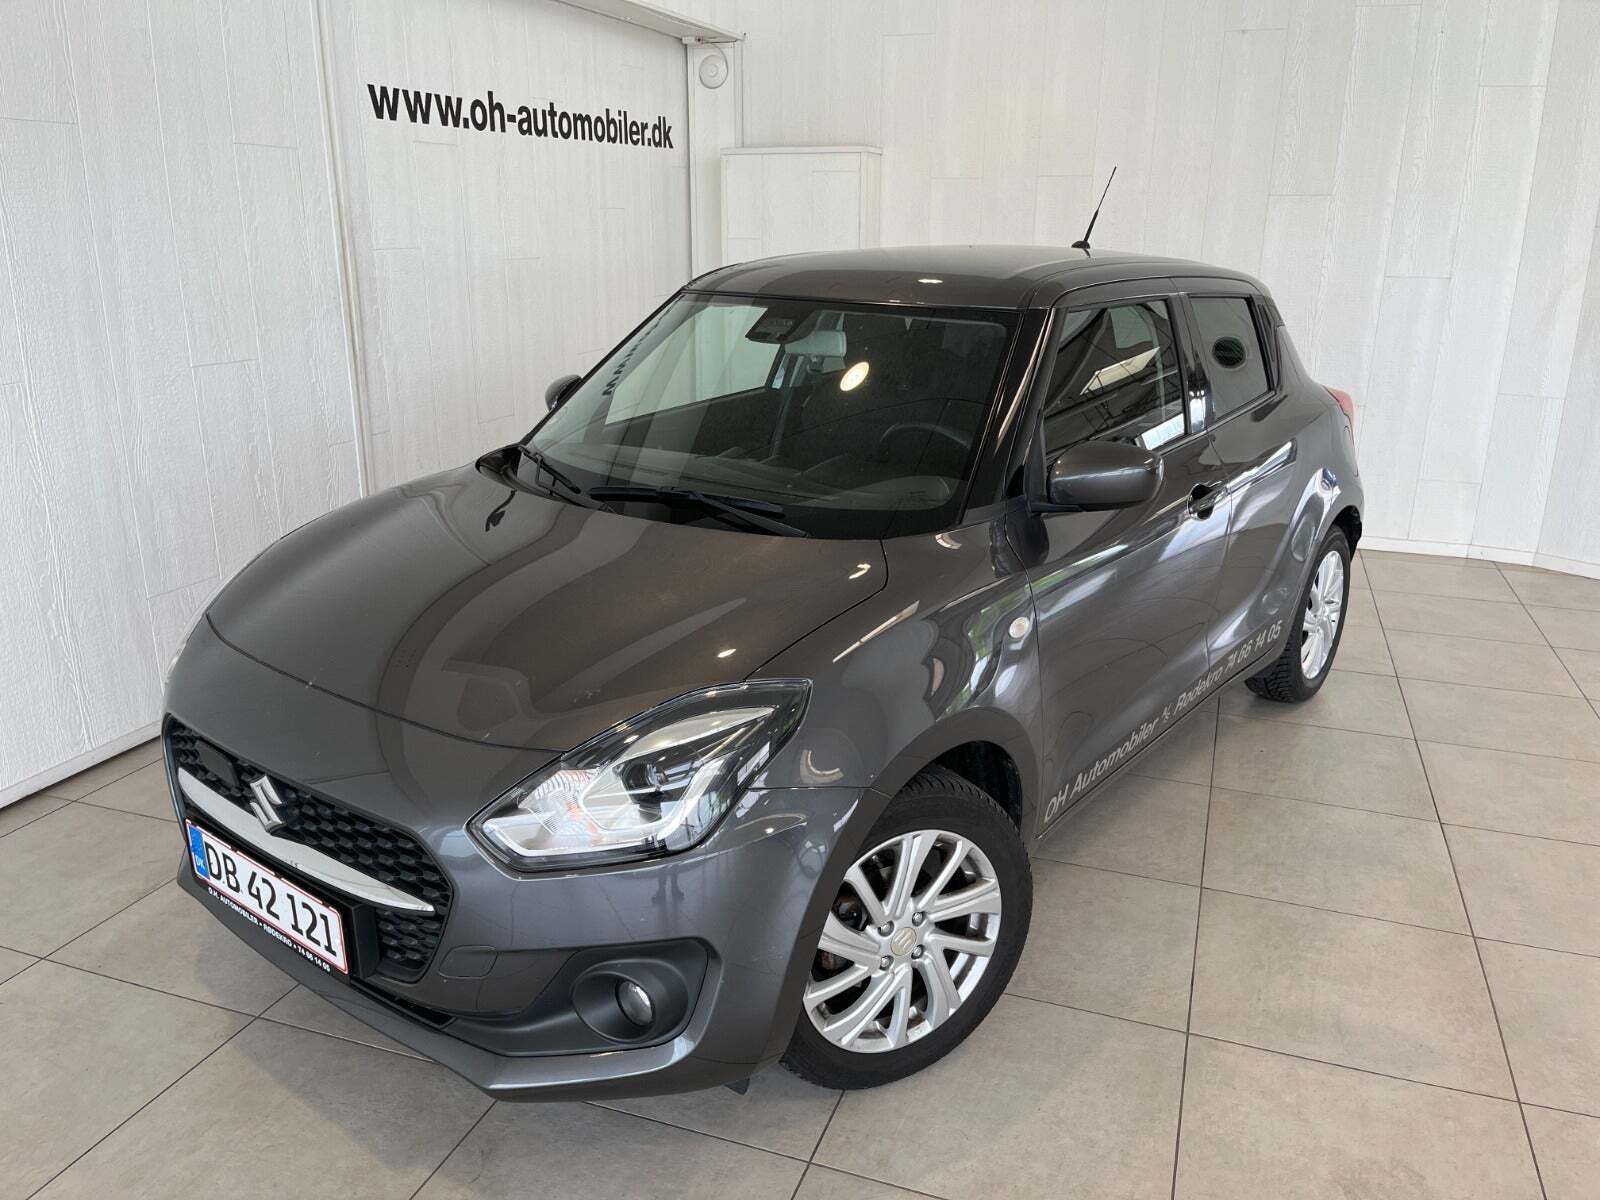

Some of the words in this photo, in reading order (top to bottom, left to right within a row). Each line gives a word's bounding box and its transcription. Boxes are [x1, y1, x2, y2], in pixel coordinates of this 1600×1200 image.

[367, 83, 674, 149] www.oh-automobiler.dk
[1043, 783, 1069, 823] OH
[1069, 717, 1160, 800] Automobiler
[1254, 629, 1267, 652] 14
[1267, 619, 1283, 643] 05
[204, 841, 241, 894] DB
[247, 870, 281, 921] 42
[286, 892, 337, 957] 121
